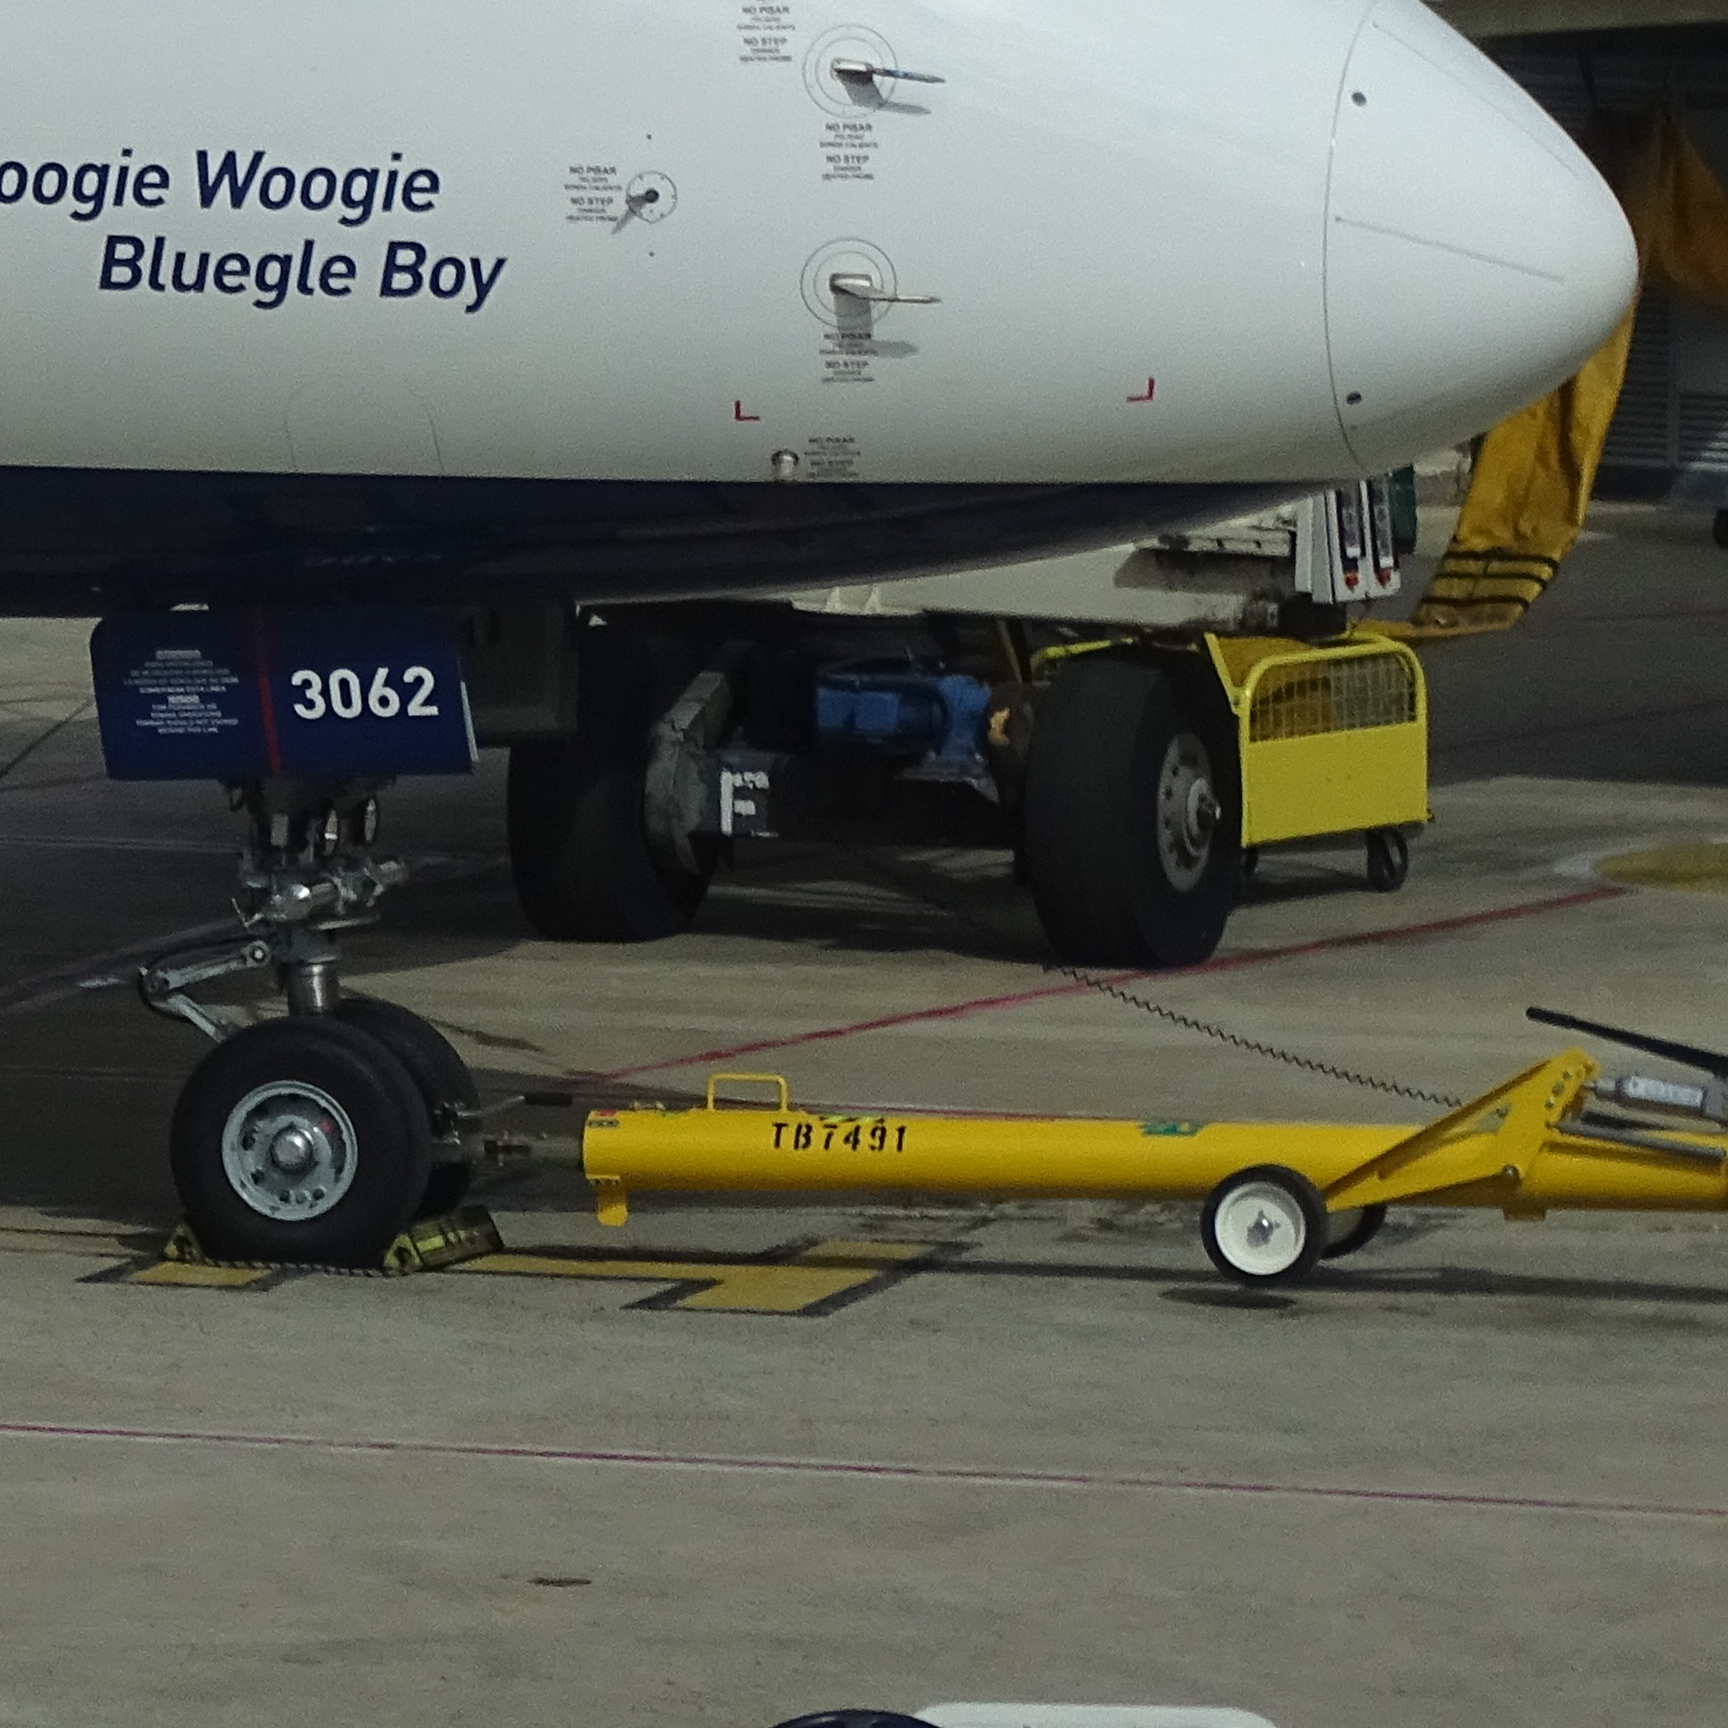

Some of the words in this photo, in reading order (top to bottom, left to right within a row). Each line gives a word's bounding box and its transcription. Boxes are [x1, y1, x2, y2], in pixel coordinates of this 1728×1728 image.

[197, 150, 440, 228] Woogie
[99, 235, 357, 311] Bluegle
[380, 241, 508, 314] Boy
[291, 666, 439, 719] 3062
[773, 1122, 906, 1153] TB7491
